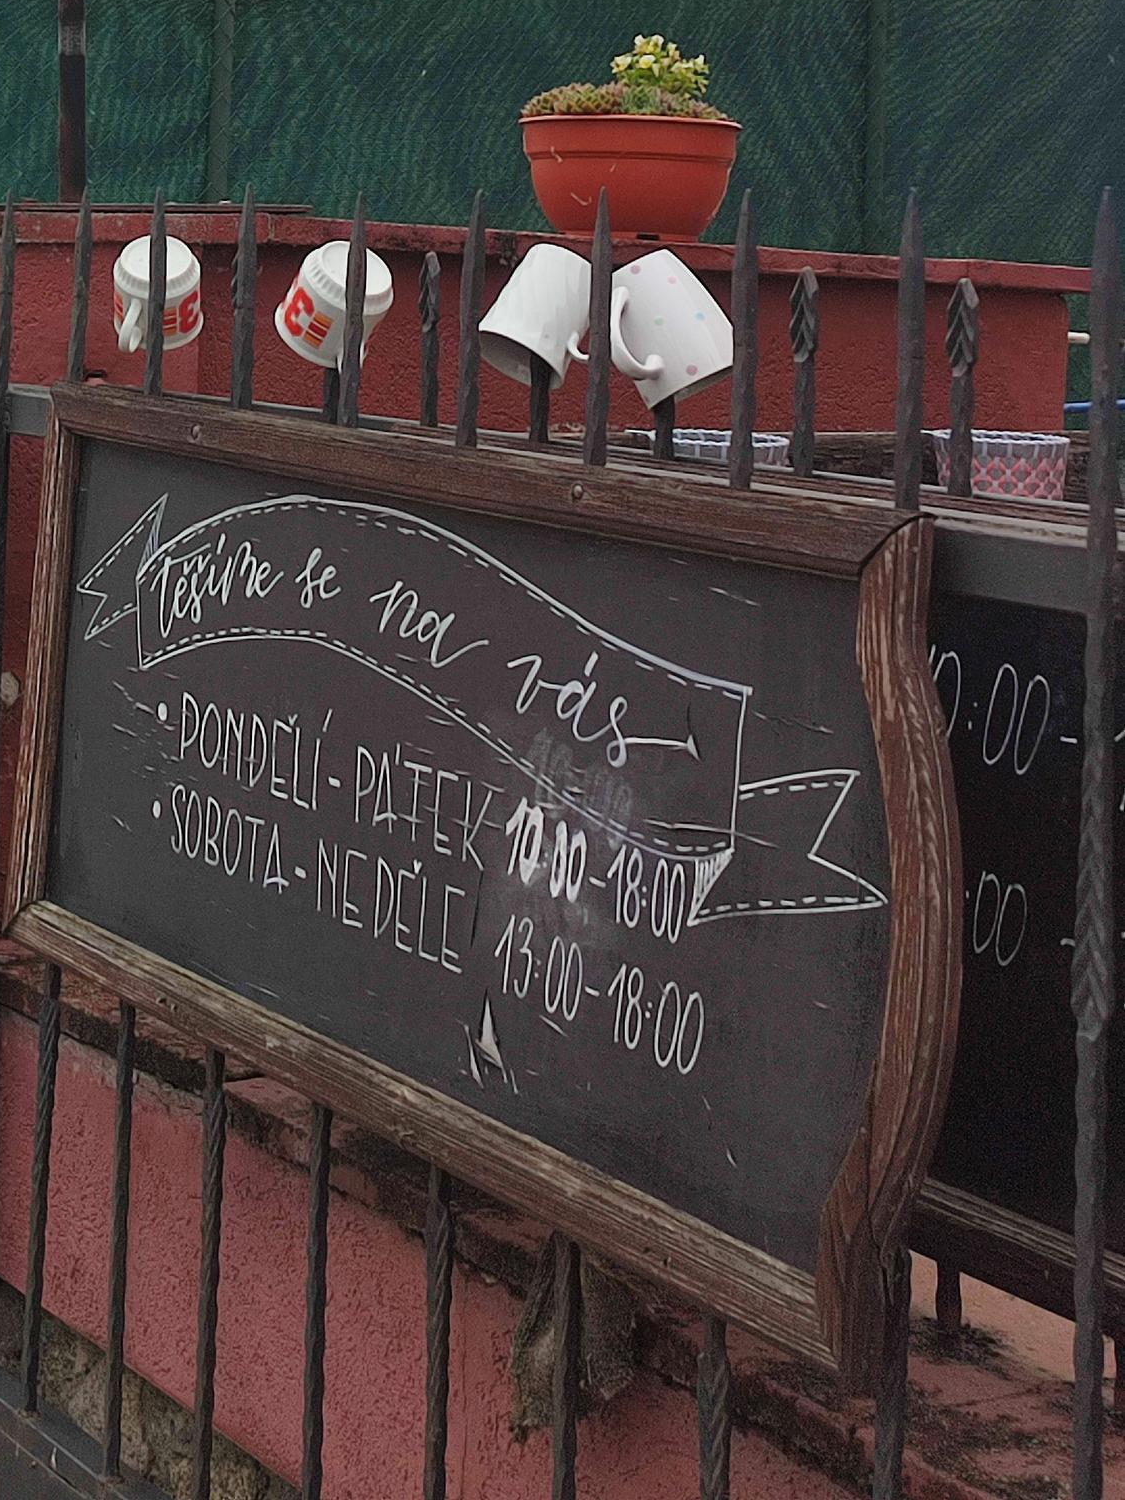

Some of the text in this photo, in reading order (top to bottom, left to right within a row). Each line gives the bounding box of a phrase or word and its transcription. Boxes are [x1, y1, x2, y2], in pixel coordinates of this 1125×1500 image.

[295, 548, 342, 609] se
[369, 580, 490, 668] na
[507, 651, 695, 768] vás
